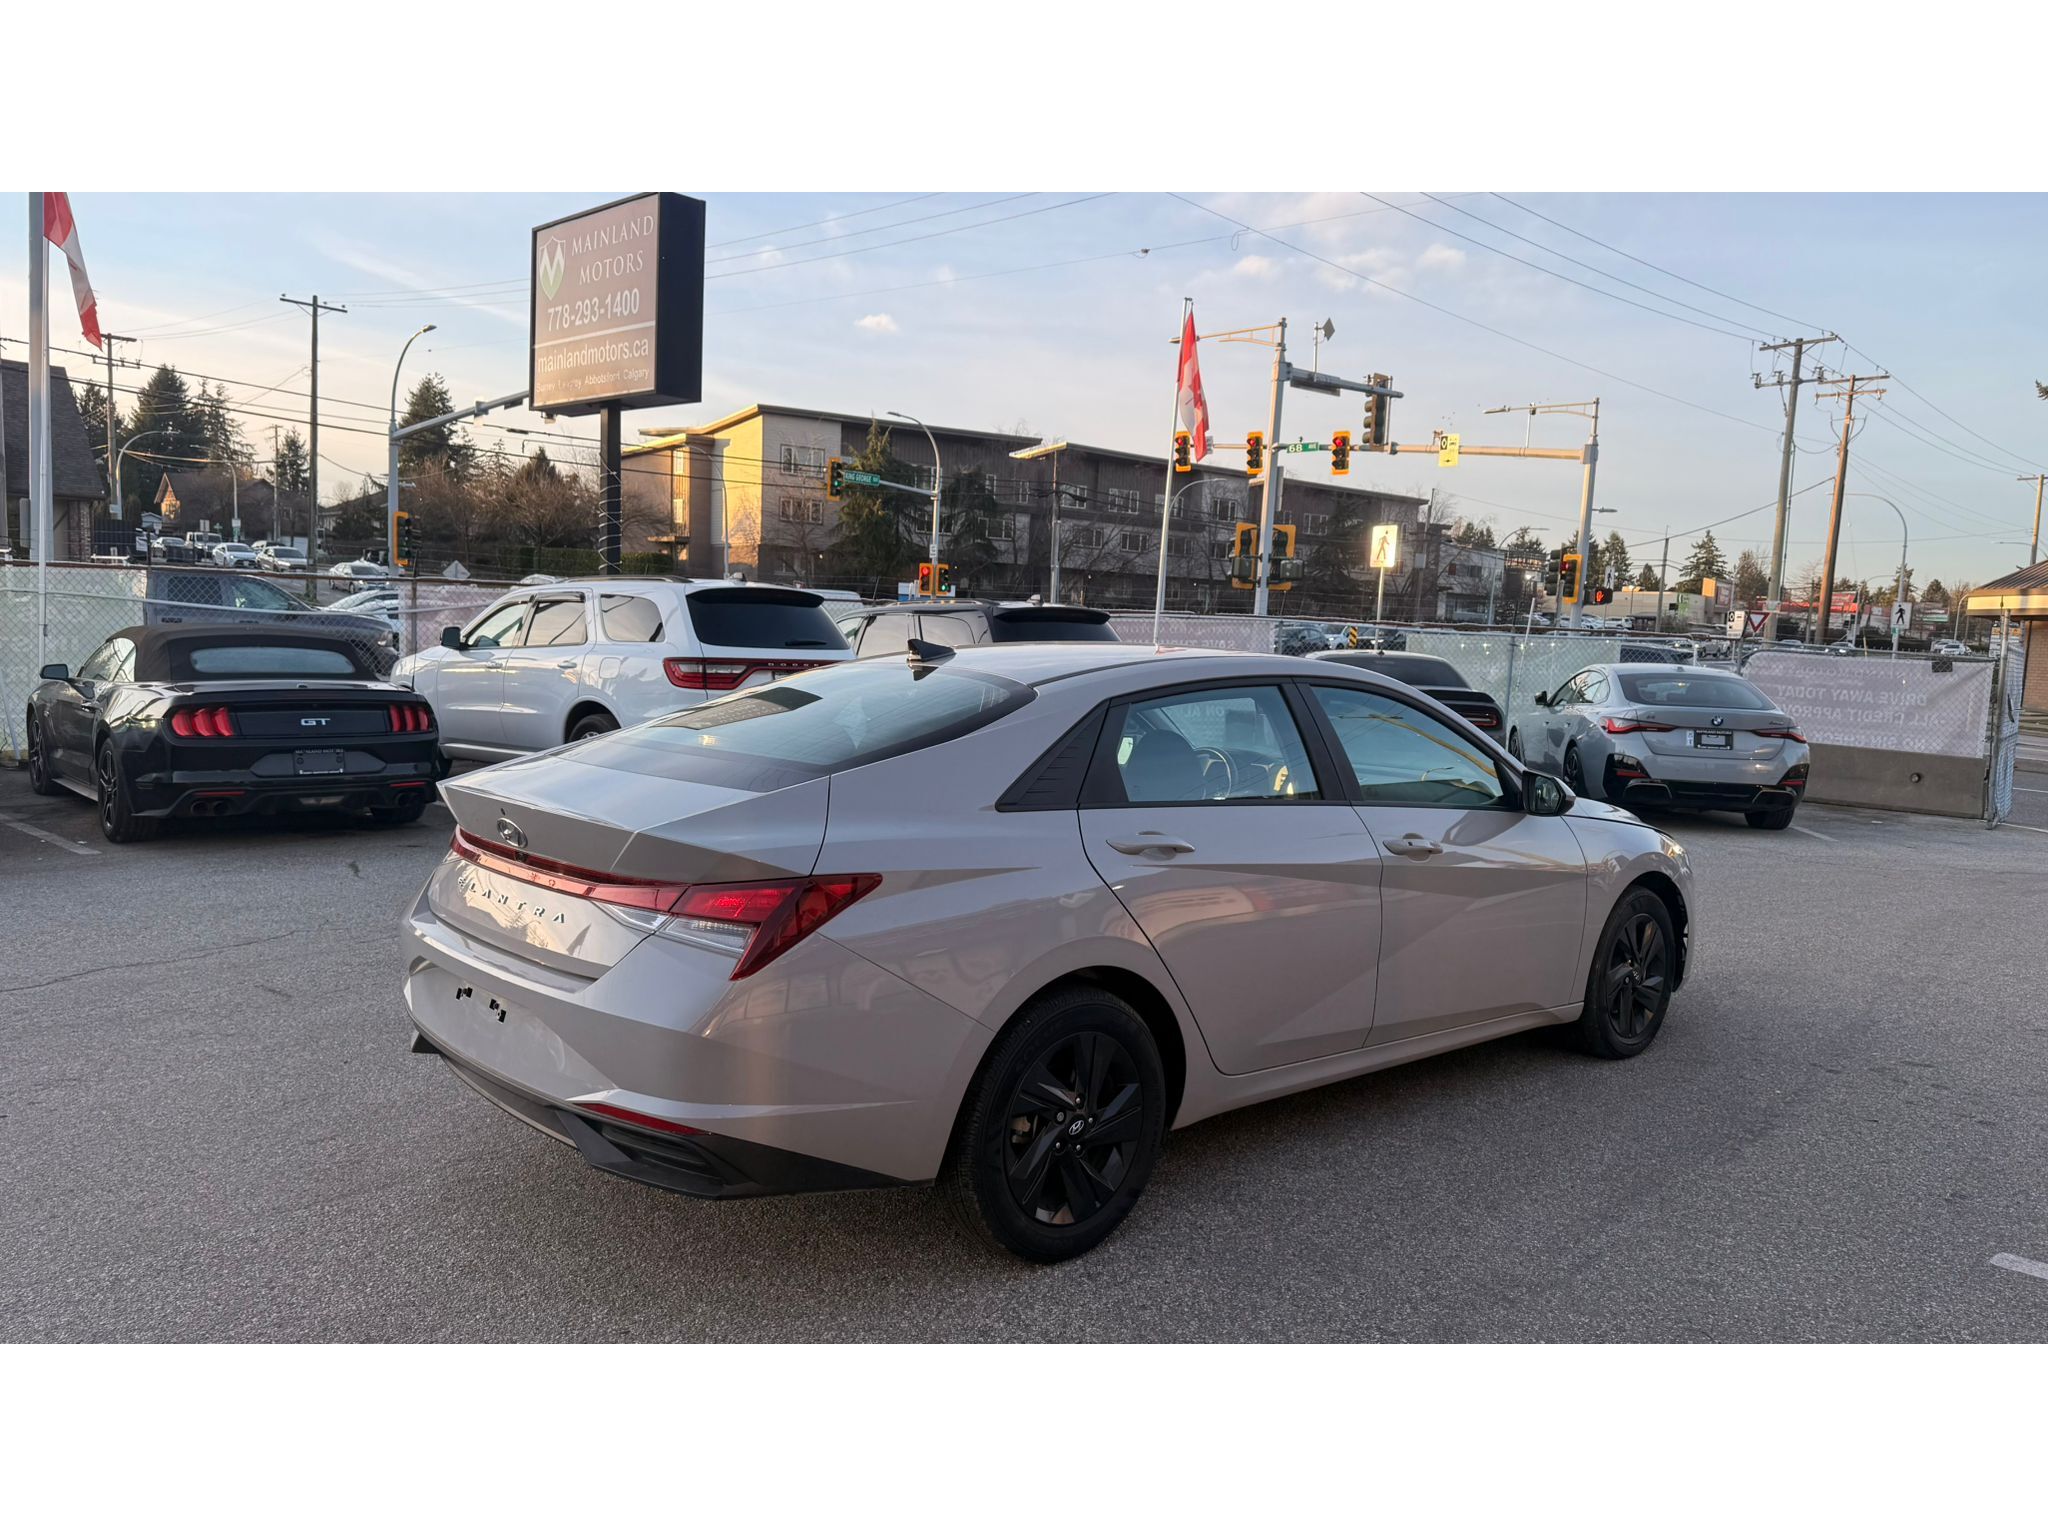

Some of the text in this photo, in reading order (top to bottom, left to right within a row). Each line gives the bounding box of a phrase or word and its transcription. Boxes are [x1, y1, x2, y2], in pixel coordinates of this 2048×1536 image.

[571, 215, 654, 257] MAINLAND
[579, 250, 644, 286] MOTORS
[547, 288, 640, 332] 778-293-1400
[537, 338, 649, 374] mainlandmotors.ca
[623, 367, 650, 382] Calgary
[1289, 443, 1303, 453] 68
[300, 717, 331, 726] GT
